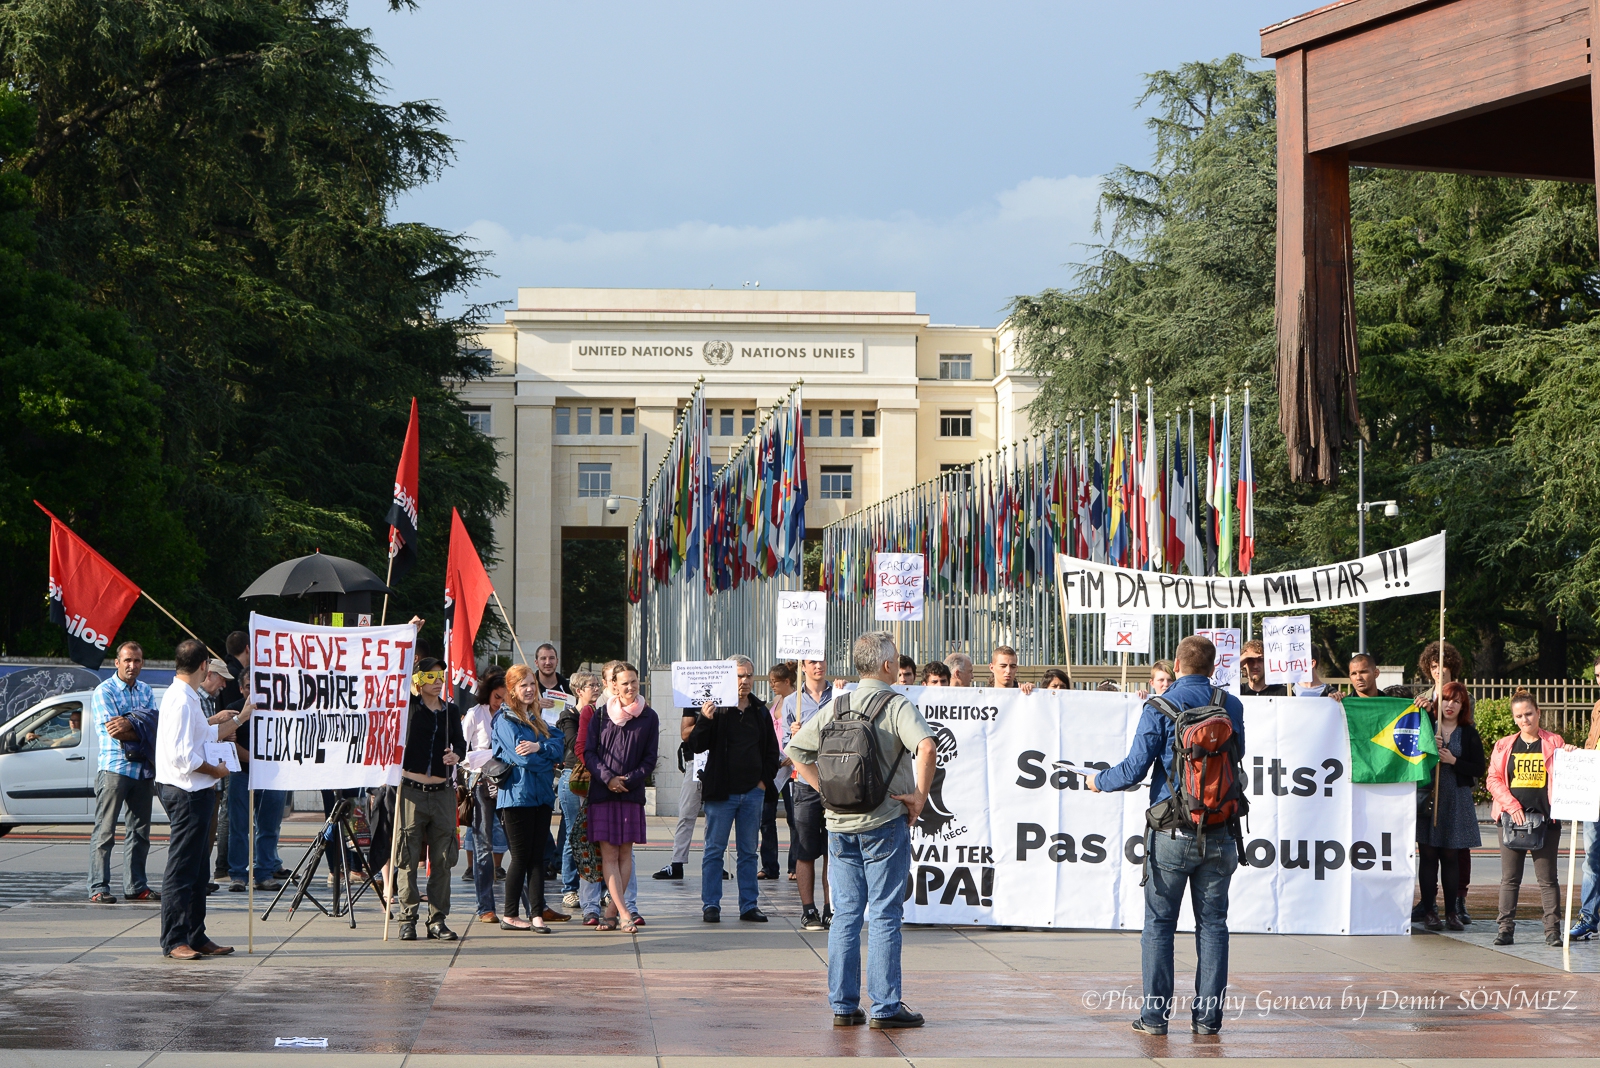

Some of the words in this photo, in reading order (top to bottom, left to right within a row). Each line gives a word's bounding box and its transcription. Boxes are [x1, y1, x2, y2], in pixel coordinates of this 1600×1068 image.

[578, 345, 627, 357] UNITED
[631, 345, 693, 357] NATIONS
[741, 347, 807, 359] NATIONS
[812, 348, 856, 359] UNIES
[878, 560, 919, 572] CARTON
[878, 572, 922, 587] ROUGE
[1114, 571, 1150, 608] DA
[1159, 575, 1256, 609] POLICIA
[1263, 562, 1369, 606] MILITAR
[1378, 547, 1410, 588] !!!
[880, 587, 903, 598] POUR
[882, 601, 915, 613] FIFA
[1264, 625, 1280, 637] NA
[1281, 624, 1306, 636] COPA
[254, 629, 348, 671] GENEVE
[361, 638, 413, 670] EST
[1286, 641, 1306, 652] TER
[1268, 658, 1308, 673] LUTA!
[363, 674, 407, 708] AVEC
[924, 704, 999, 721] DIREITOS?
[254, 715, 293, 761] CEUX
[346, 714, 367, 764] AU
[936, 750, 958, 767] 2014
[1517, 759, 1545, 773] FREE
[1516, 773, 1544, 781] ASSANGE
[1016, 822, 1107, 865] Pas
[955, 845, 995, 864] TER
